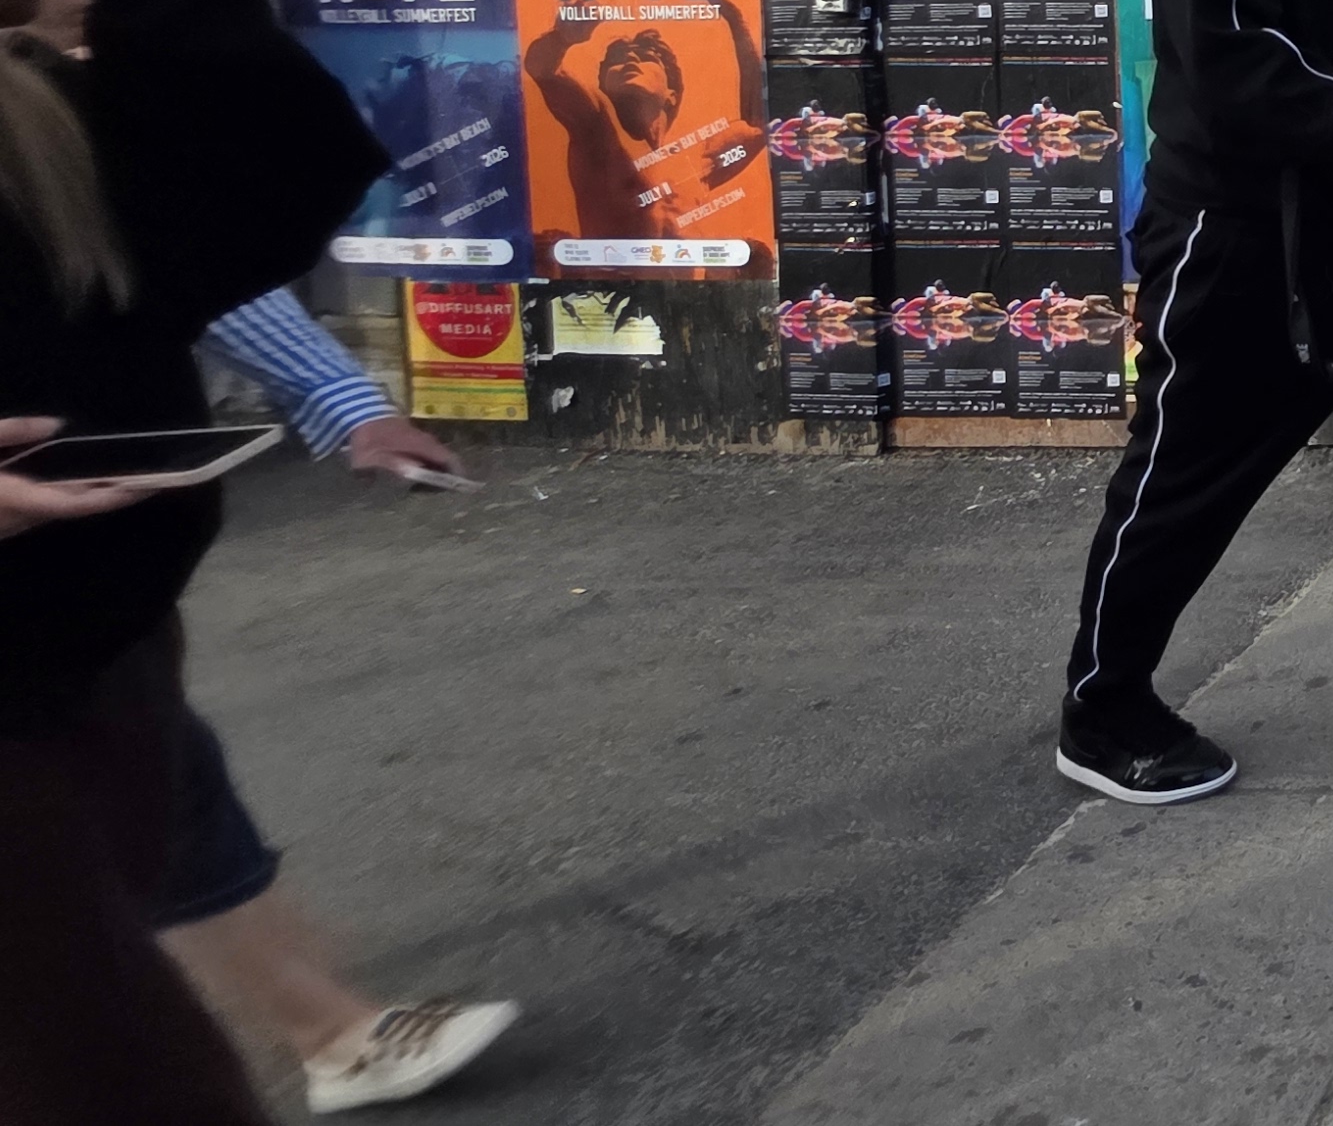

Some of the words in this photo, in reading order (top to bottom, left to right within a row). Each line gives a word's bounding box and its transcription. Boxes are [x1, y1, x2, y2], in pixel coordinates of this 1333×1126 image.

[393, 8, 477, 23] SUMMERFEST
[560, 5, 635, 21] VOLLEYBALL
[640, 4, 721, 20] SUMMERFEST
[680, 134, 700, 150] BAY
[699, 117, 730, 141] BEACH
[481, 145, 509, 167] 2026
[719, 145, 746, 167] 2026
[638, 187, 662, 208] JULY
[439, 323, 492, 335] MEDIA
